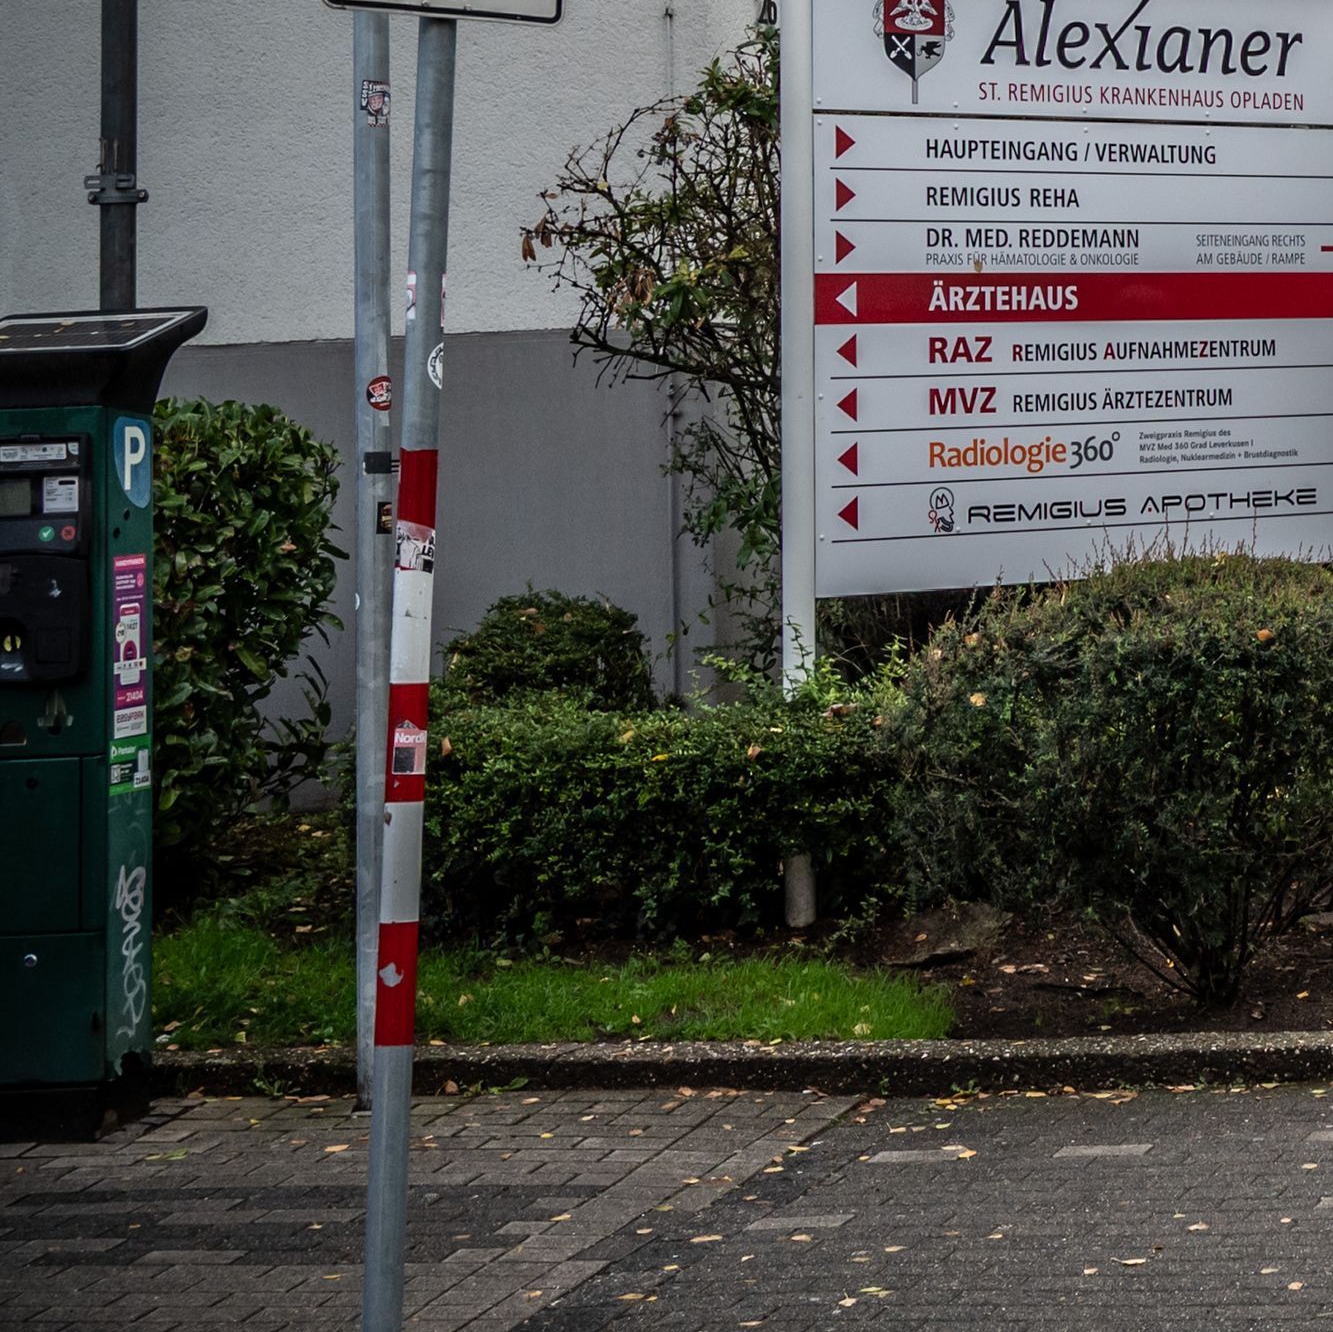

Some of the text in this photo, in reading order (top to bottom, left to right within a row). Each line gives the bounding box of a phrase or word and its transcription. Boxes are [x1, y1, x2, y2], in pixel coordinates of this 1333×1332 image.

[978, 81, 1304, 111] ST. REMIGIUS KRANKENHAUS OPLADEN
[926, 139, 1078, 163] HAUPTEINGANG
[1095, 143, 1217, 165] VERWALTUNG
[926, 186, 1080, 209] REMIGIUS REHA
[926, 228, 1140, 248] DR. MED. REDDEMANN
[1196, 234, 1306, 247] SEITENEINGANG RECHTS
[926, 250, 1140, 266] PRAXIS FÜR HÄMATOLOGIE & ONKOLOGIE
[1196, 253, 1213, 265] AM
[1216, 250, 1263, 266] GEBÄUDE
[1272, 252, 1306, 265] RAMPE
[928, 279, 1078, 313] ÄRZTEHAUS
[928, 336, 1276, 364] RAZ REMIGIUS AUFNAHMEZENTRUM
[928, 386, 1233, 415] MVZ REMIGIUS ÄRZTEZENTRUM
[1139, 429, 1231, 441] Zweigpraxis Remigius des
[1139, 444, 1156, 452] MVZ
[1157, 442, 1173, 451] Med
[1174, 441, 1189, 450] 360
[1191, 441, 1208, 449] Grad
[1209, 439, 1249, 449] Leverkusen
[123, 425, 146, 491] P
[1139, 454, 1179, 464] Radiologie,
[1181, 452, 1236, 462] Nuklearmedizin
[1244, 449, 1299, 460] Brustdiagnostik
[968, 487, 1318, 524] REMIGIUS APOTHEKE
